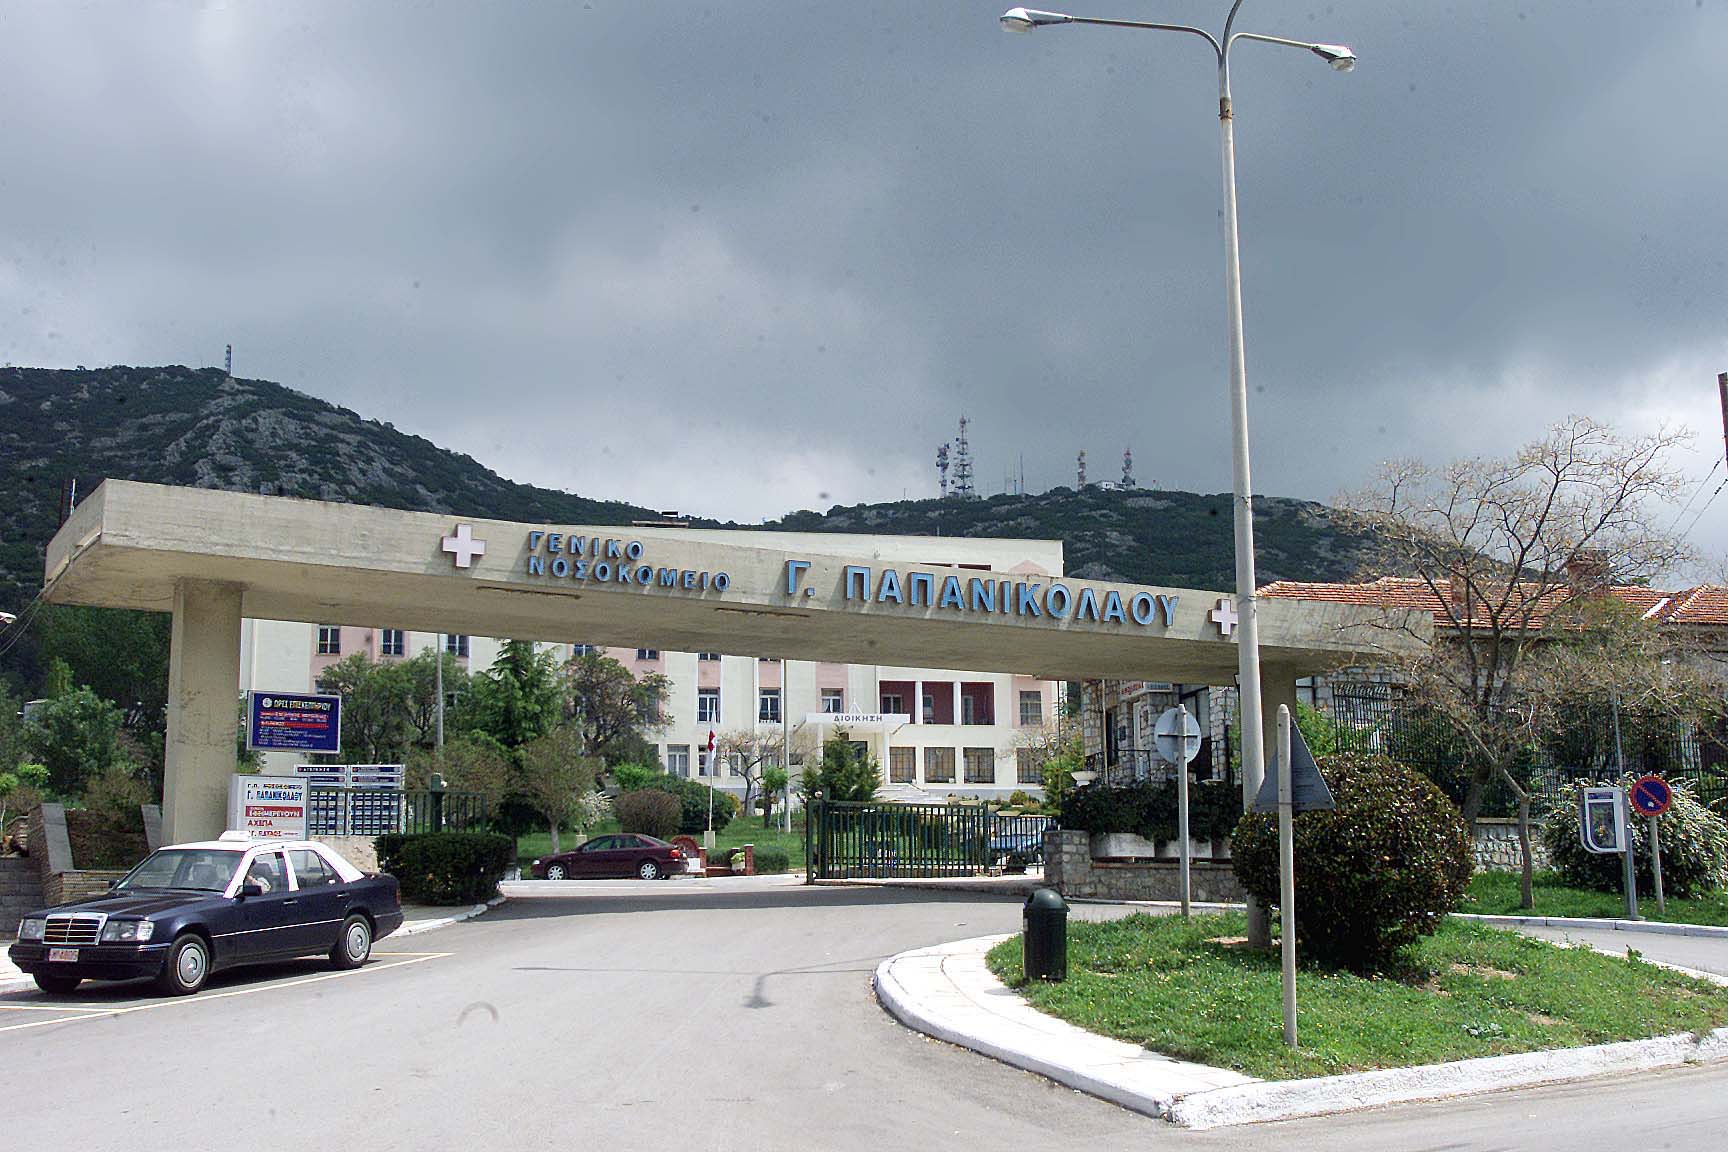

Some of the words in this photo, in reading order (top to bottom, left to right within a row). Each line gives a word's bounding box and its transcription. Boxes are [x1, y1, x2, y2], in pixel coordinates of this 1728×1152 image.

[528, 530, 644, 561] ΓΕΝΙΚΟ
[528, 554, 731, 593] ΝΟΣΟΚΟΜΕΙΟ
[784, 559, 816, 597] Γ.
[843, 565, 1179, 627] ΠΑΠΑΝΙΚΟΛΑΟΥ
